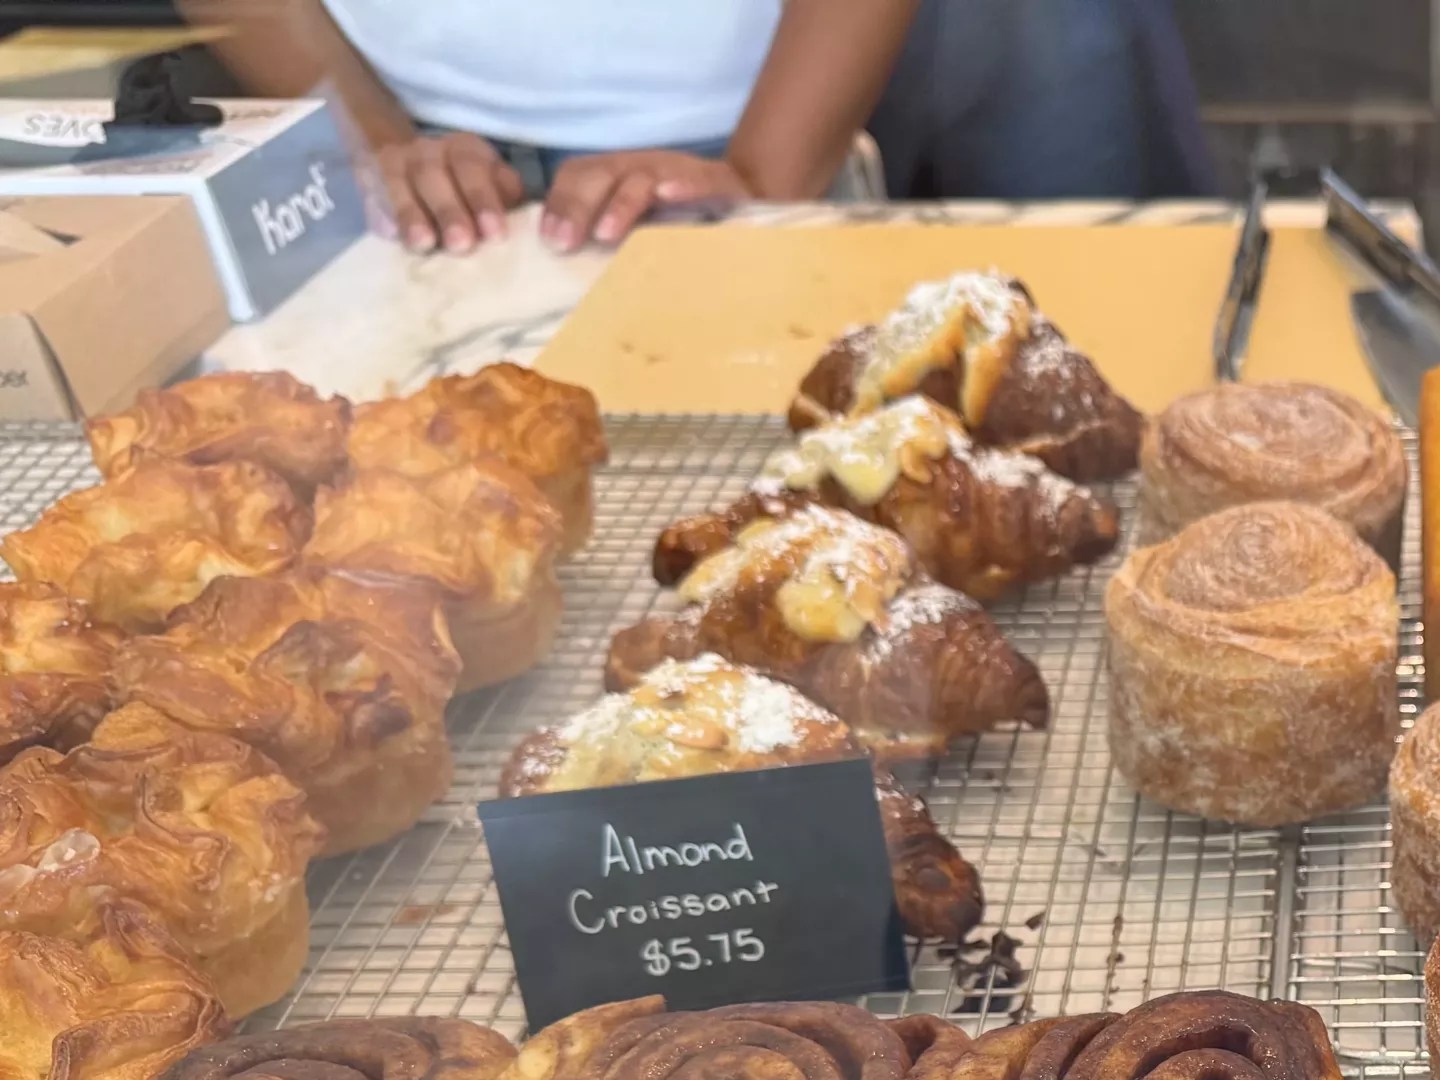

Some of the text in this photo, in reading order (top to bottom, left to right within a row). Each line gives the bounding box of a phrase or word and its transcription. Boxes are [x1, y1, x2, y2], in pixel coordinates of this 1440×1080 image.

[602, 823, 754, 877] Almond
[569, 880, 780, 935] Croissant
[641, 928, 766, 977] $5.75
